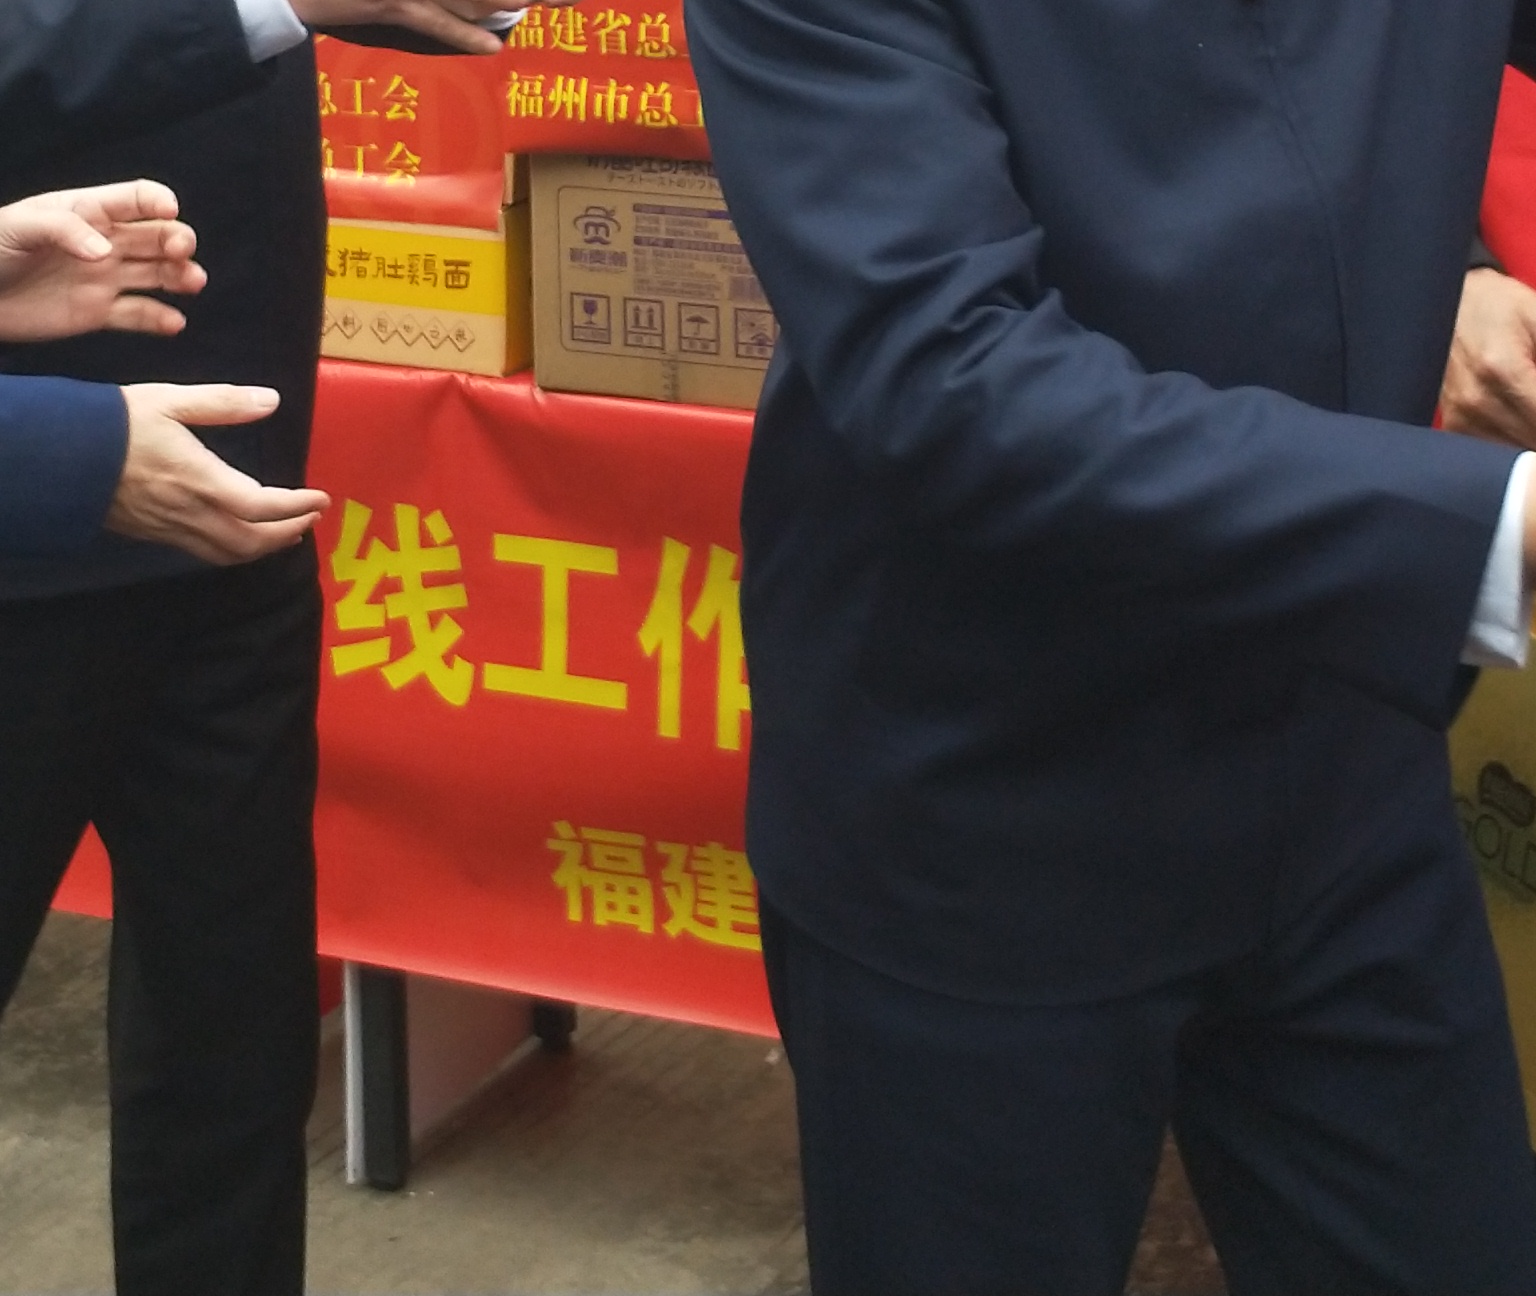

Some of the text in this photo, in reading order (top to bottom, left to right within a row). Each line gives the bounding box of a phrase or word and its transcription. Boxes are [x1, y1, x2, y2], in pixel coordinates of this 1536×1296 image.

[508, 5, 690, 59] 福建省总
[330, 498, 751, 751] 线工作
[546, 819, 763, 952] 福建
